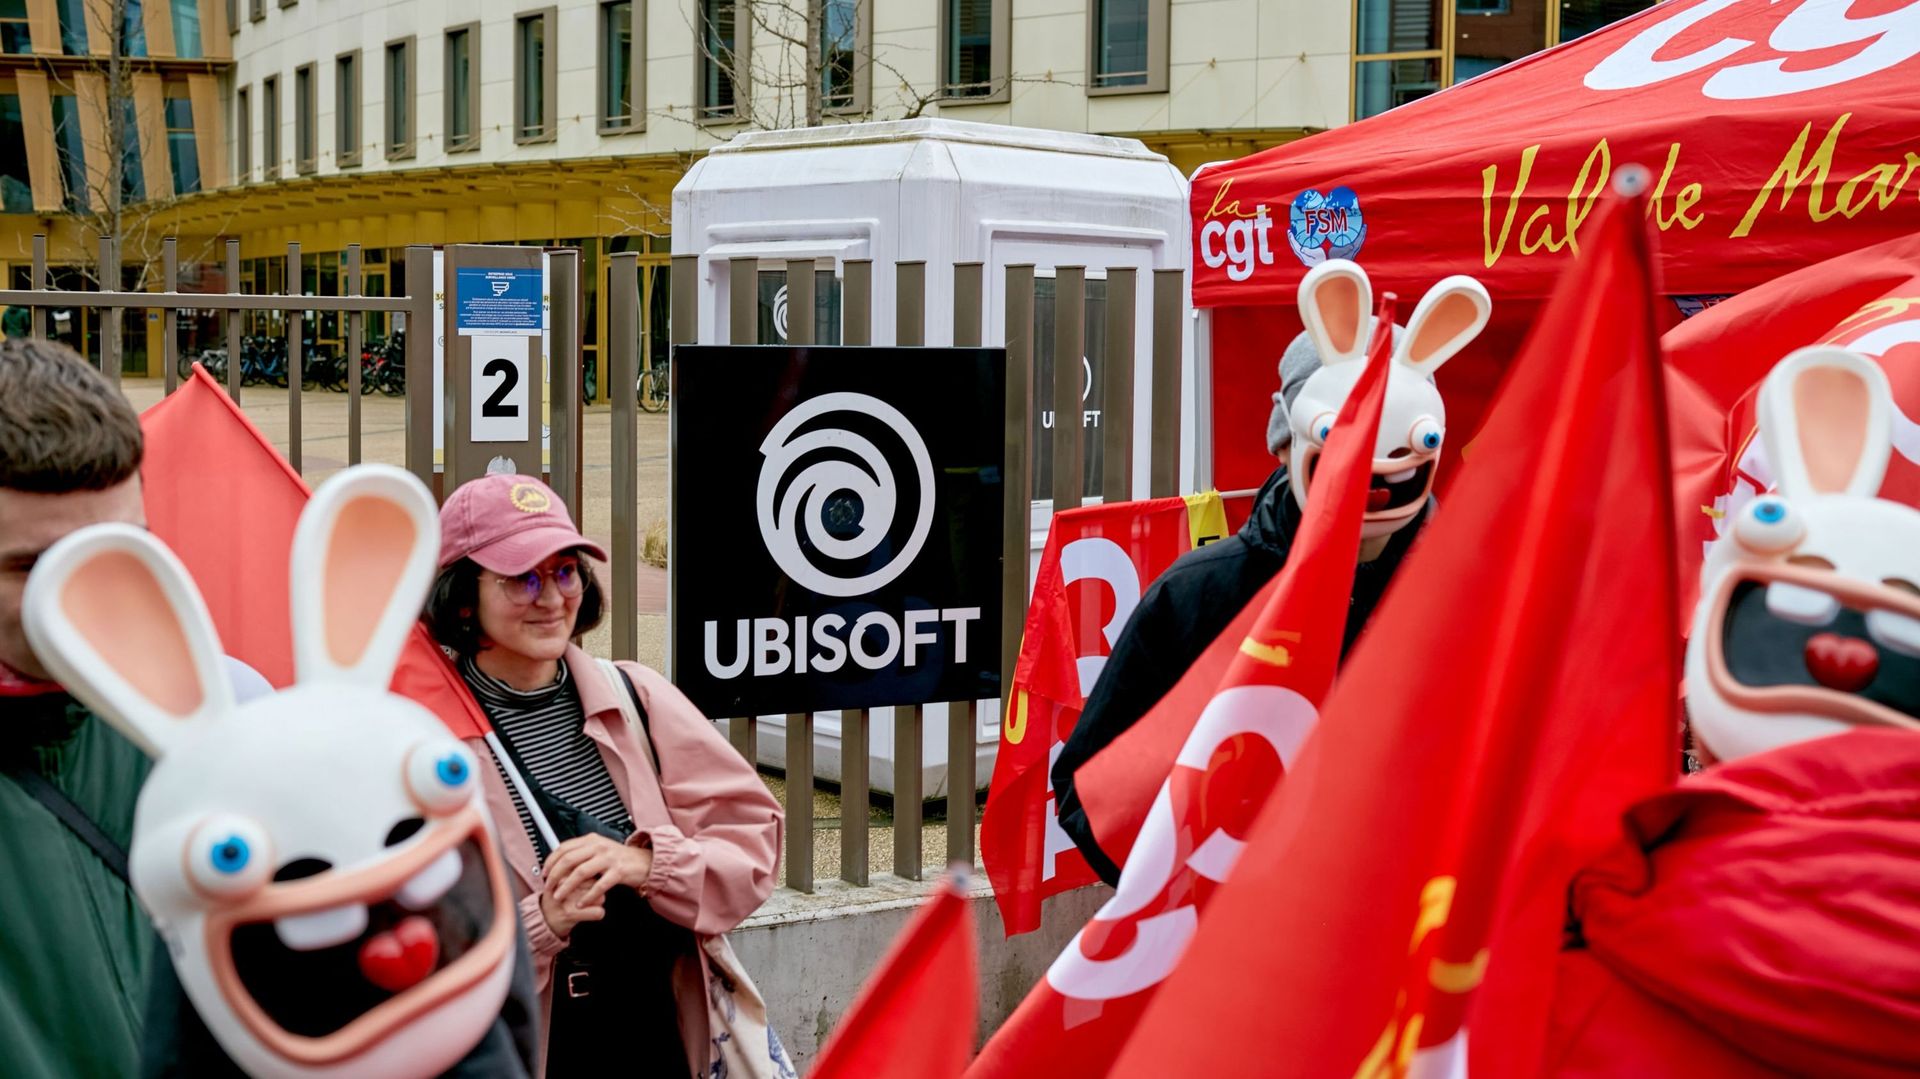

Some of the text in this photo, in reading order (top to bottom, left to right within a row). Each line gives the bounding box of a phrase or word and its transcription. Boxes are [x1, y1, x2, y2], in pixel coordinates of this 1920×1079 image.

[1204, 178, 1272, 221] la
[1304, 207, 1349, 235] FSM
[1482, 138, 1611, 268] Val
[1200, 205, 1275, 281] cgt
[482, 358, 519, 418] 2
[704, 606, 981, 680] UBISOFT
